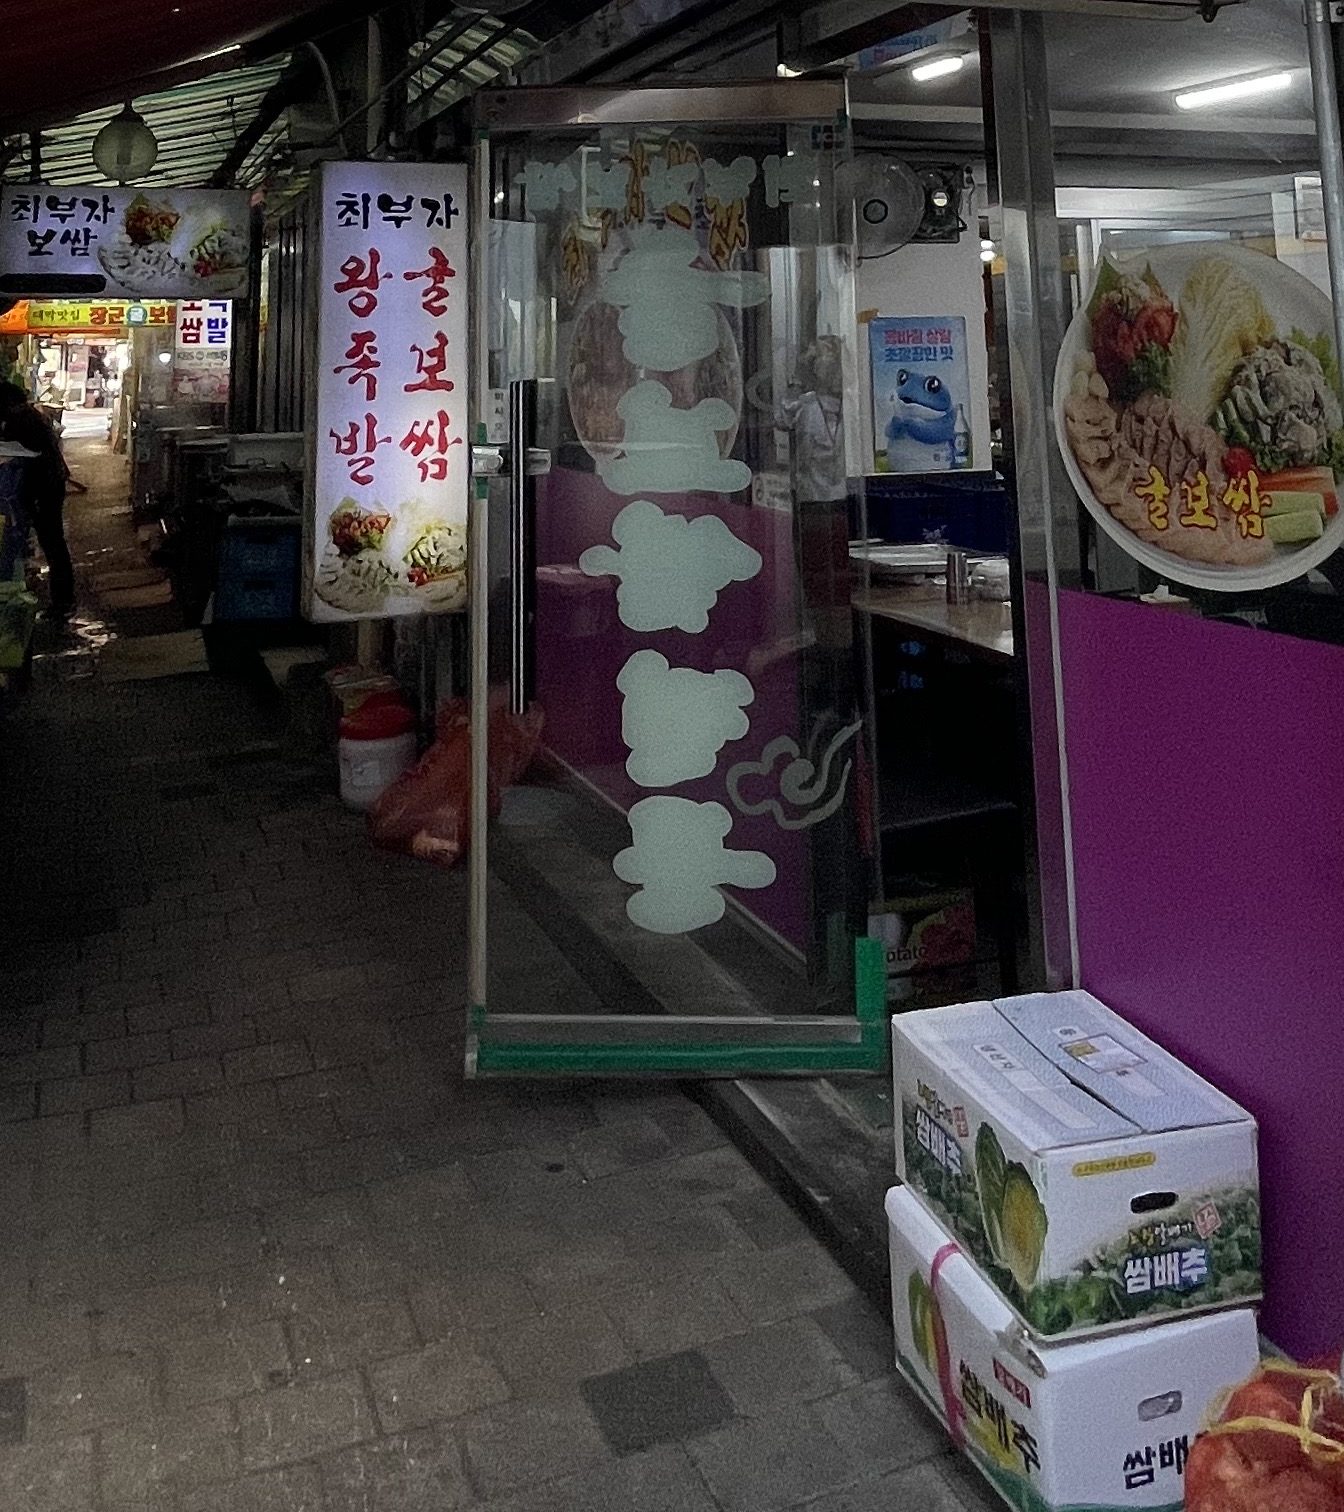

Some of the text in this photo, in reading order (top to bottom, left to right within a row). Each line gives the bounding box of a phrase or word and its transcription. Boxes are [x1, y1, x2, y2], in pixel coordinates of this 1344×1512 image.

[10, 194, 115, 224] 최부자
[335, 192, 459, 230] 최부자
[26, 227, 98, 257] 보쌈
[886, 946, 929, 963] otato
[1123, 1248, 1208, 1295] 쌈배추
[1122, 1434, 1189, 1490] 쌈배
